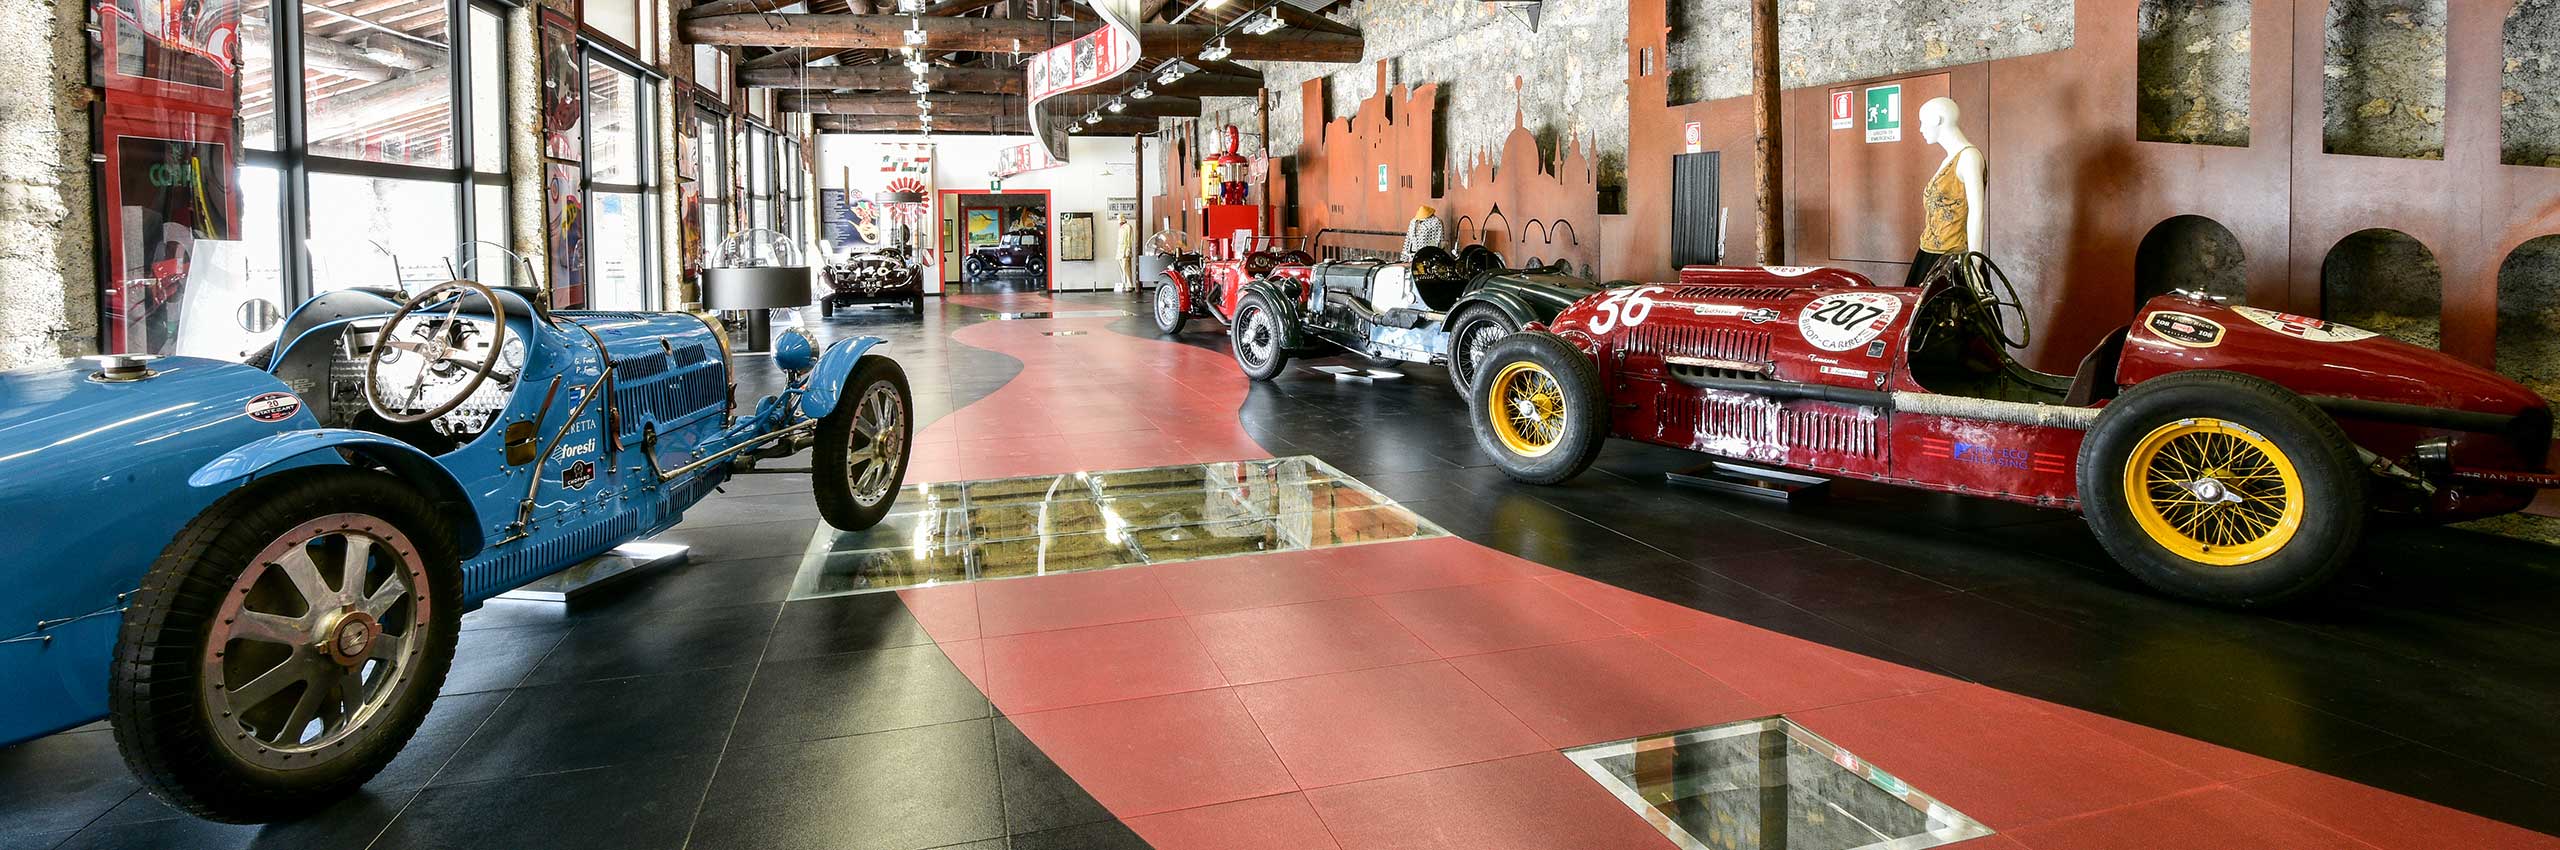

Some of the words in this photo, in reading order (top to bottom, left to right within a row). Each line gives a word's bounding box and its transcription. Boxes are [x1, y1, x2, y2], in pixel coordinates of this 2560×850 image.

[1589, 286, 1665, 335] 36
[1811, 299, 1885, 331] 207
[2155, 319, 2171, 327] 108
[2198, 330, 2213, 338] 108
[266, 400, 279, 408] 20
[559, 419, 597, 436] RETTA
[562, 437, 596, 459] foresti
[2462, 471, 2508, 480] BRIAN
